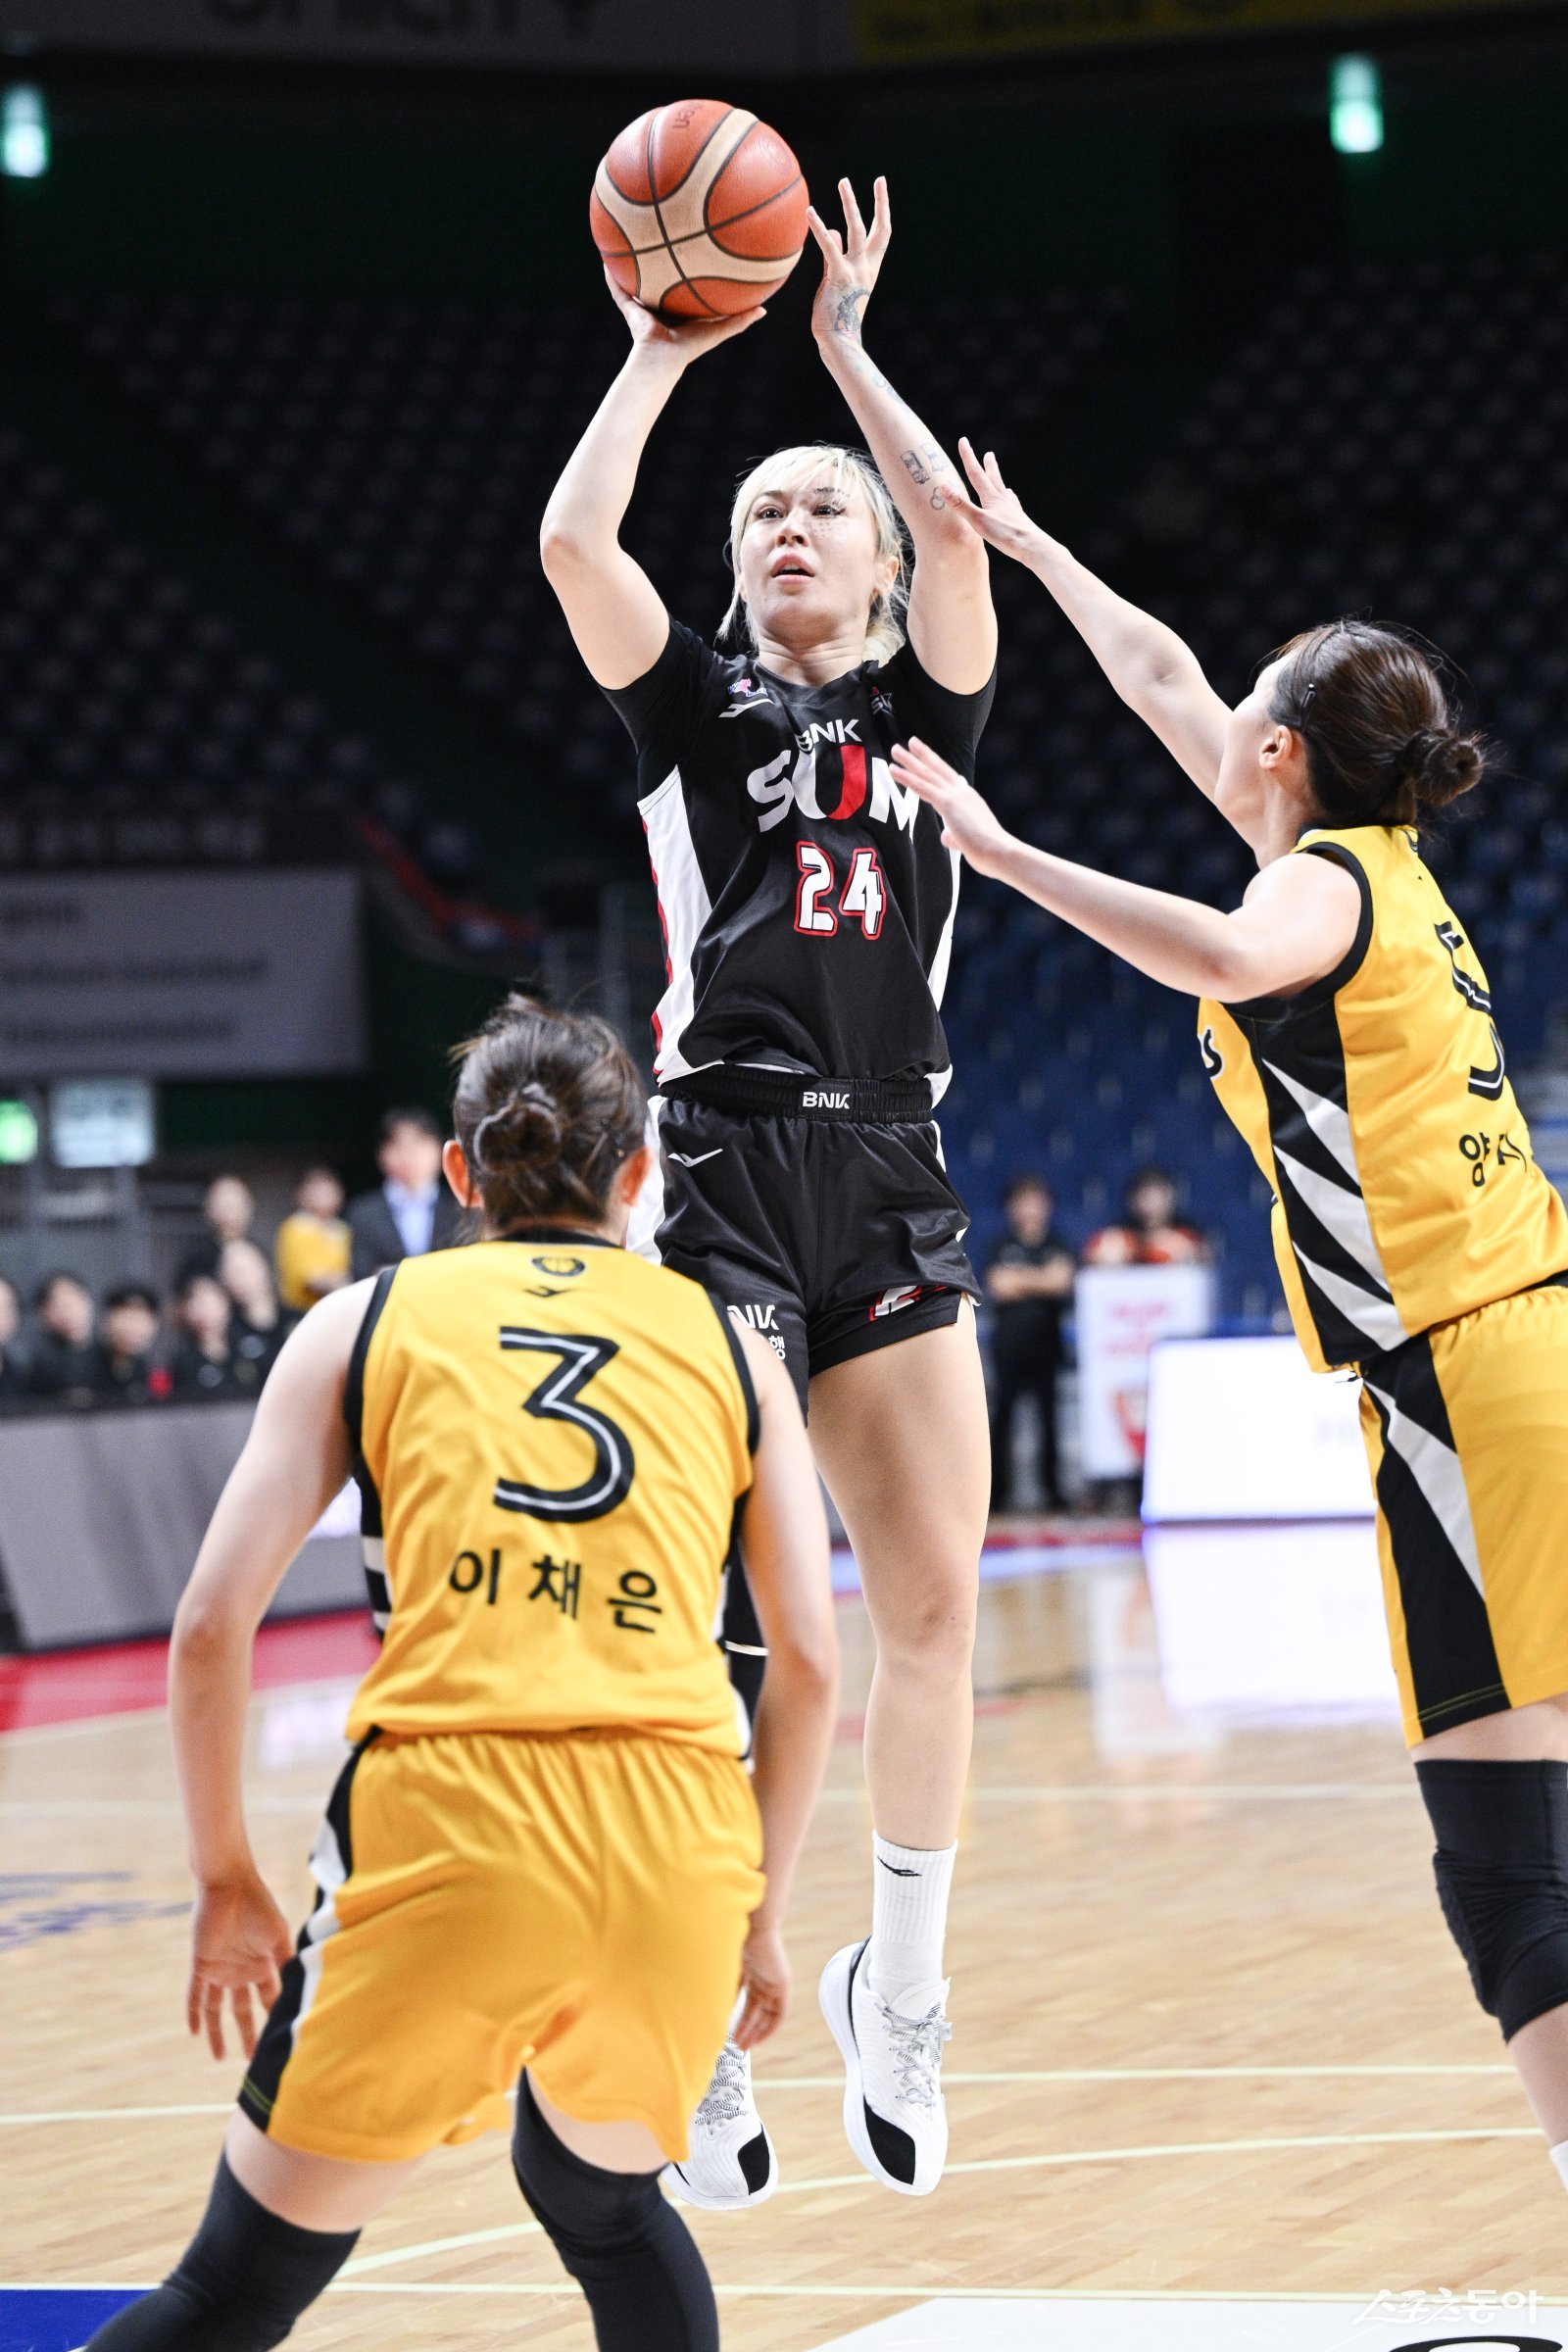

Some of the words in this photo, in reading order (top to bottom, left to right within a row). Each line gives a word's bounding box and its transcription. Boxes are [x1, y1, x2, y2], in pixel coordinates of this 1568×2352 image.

[797, 718, 862, 755] BNK
[793, 840, 886, 941] 24
[802, 1091, 851, 1109] BNK
[726, 1303, 780, 1331] NK
[493, 1326, 636, 1524] 3
